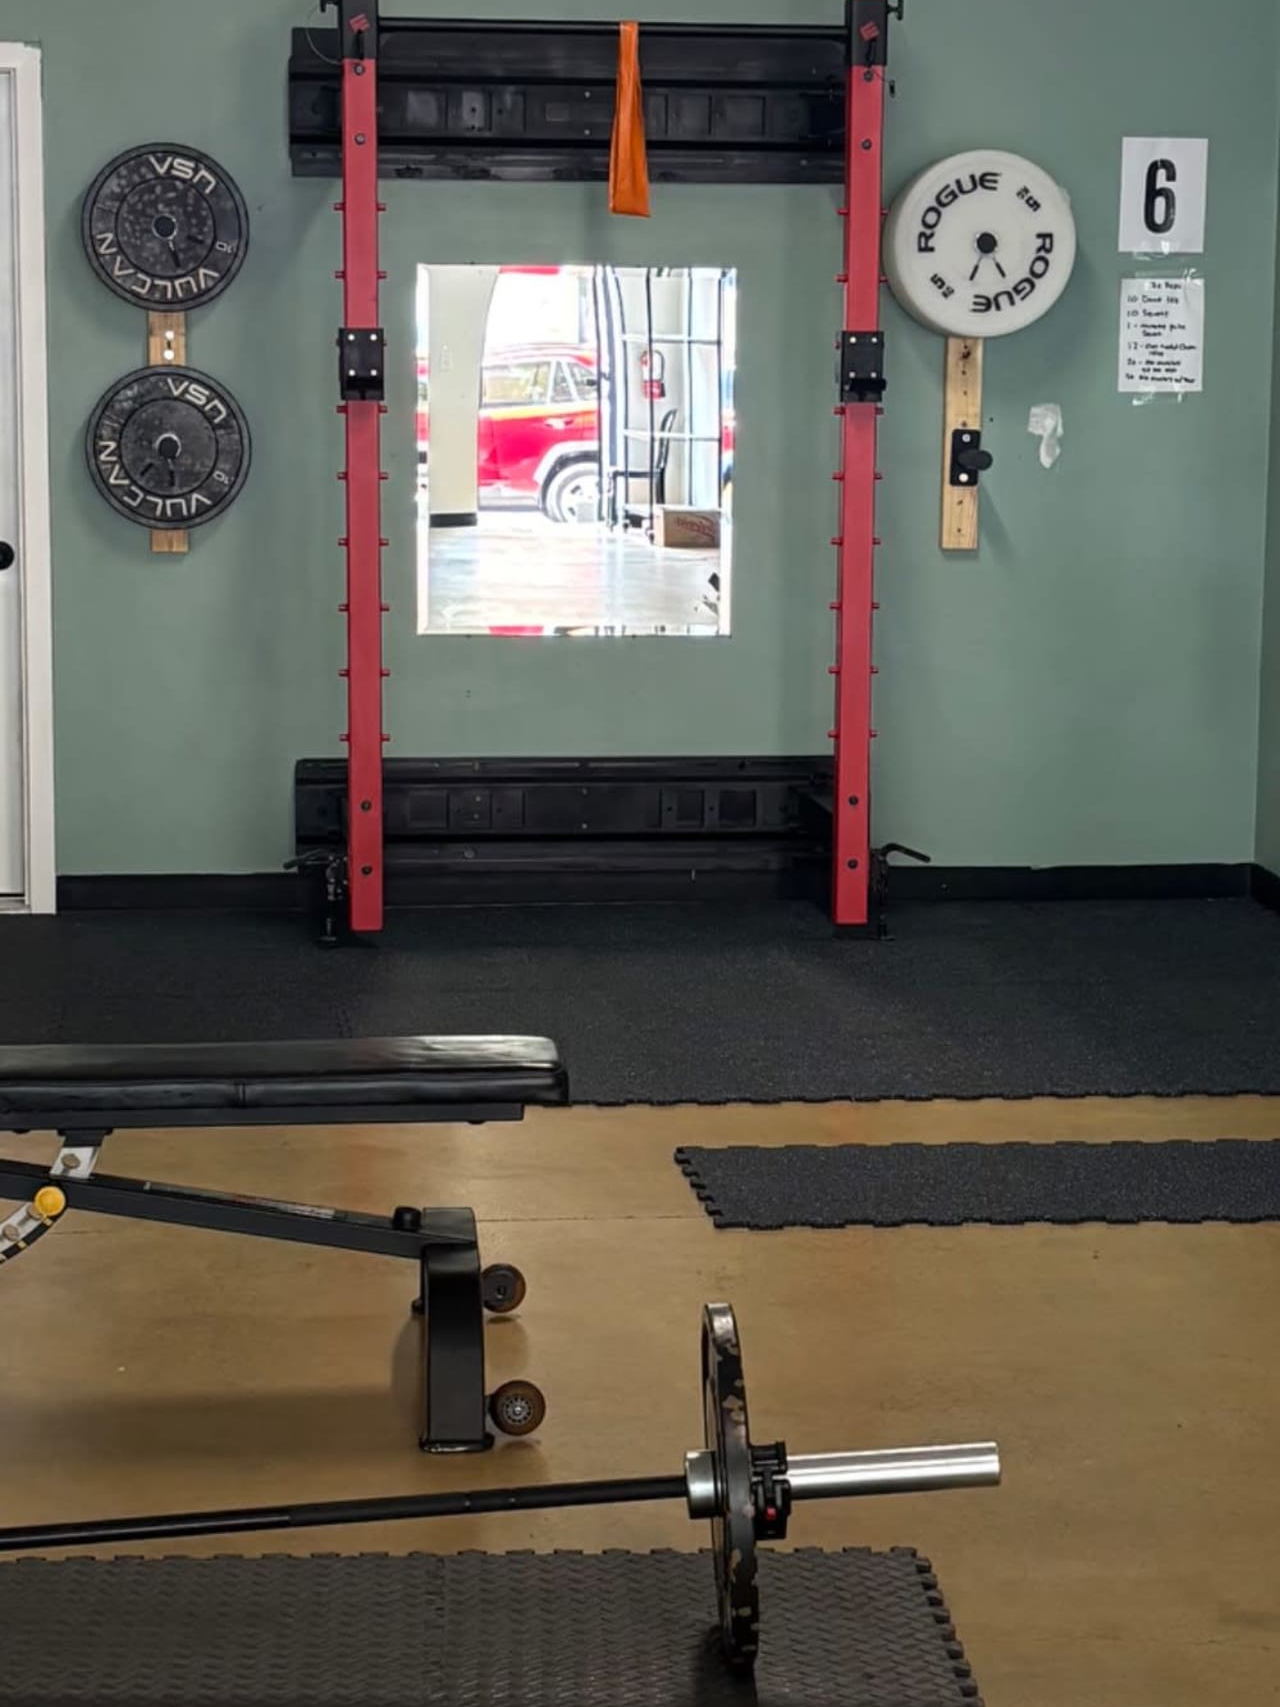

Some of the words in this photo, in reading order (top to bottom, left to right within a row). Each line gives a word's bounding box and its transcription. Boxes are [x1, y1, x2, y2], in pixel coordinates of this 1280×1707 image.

[149, 155, 217, 195] USA
[917, 171, 1003, 254] ROGUE
[1143, 158, 1178, 234] 6
[95, 230, 220, 300] VULCAN
[970, 231, 1054, 313] ROGUE
[165, 376, 227, 424] USA
[98, 440, 212, 518] VULCAN
